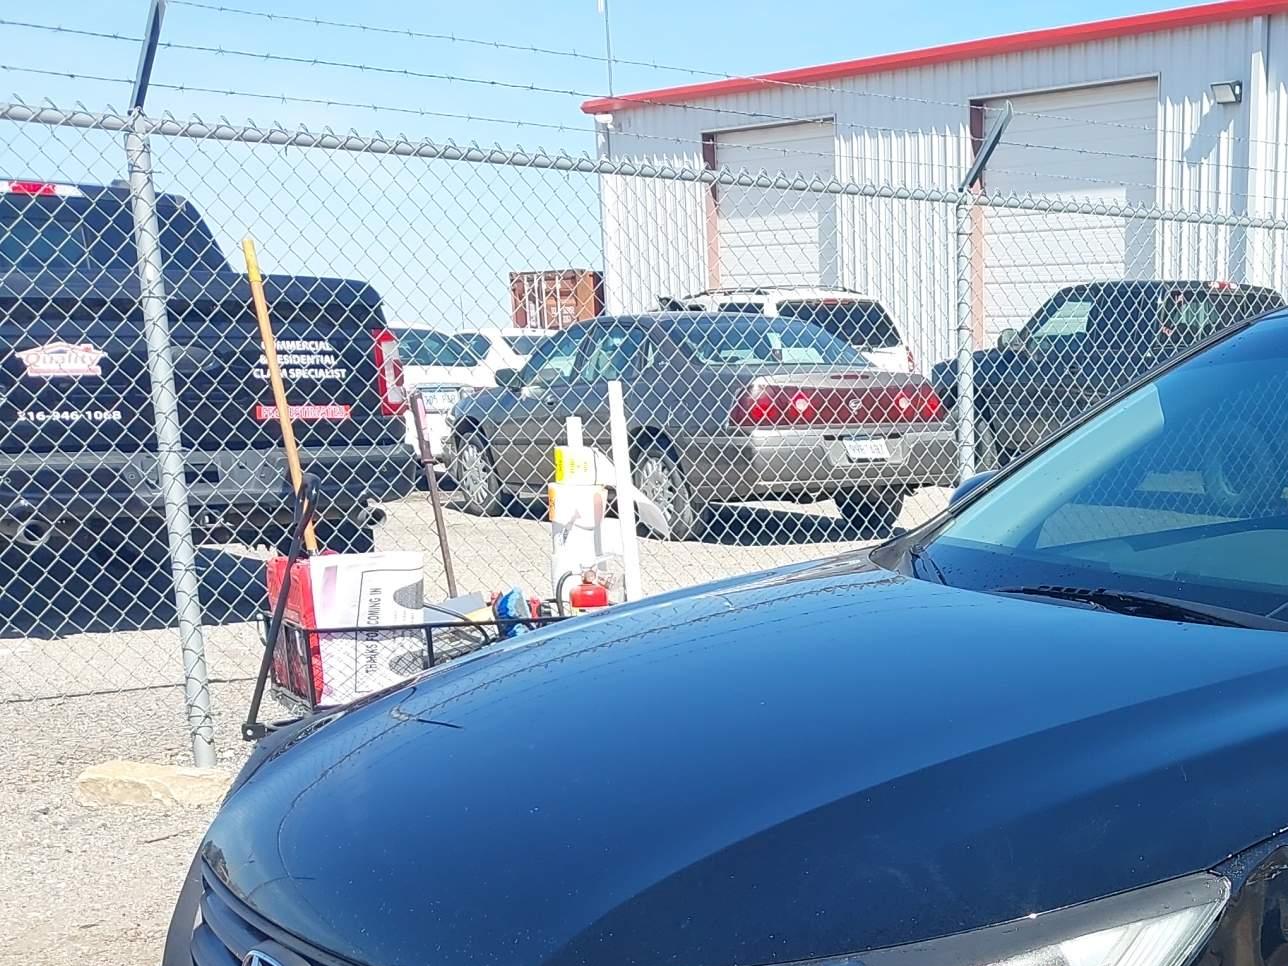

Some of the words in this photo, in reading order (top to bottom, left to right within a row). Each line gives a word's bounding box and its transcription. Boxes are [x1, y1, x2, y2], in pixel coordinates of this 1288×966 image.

[275, 354, 336, 365] ESIDENTIAL
[369, 587, 382, 596] IN
[367, 597, 381, 625] COMING
